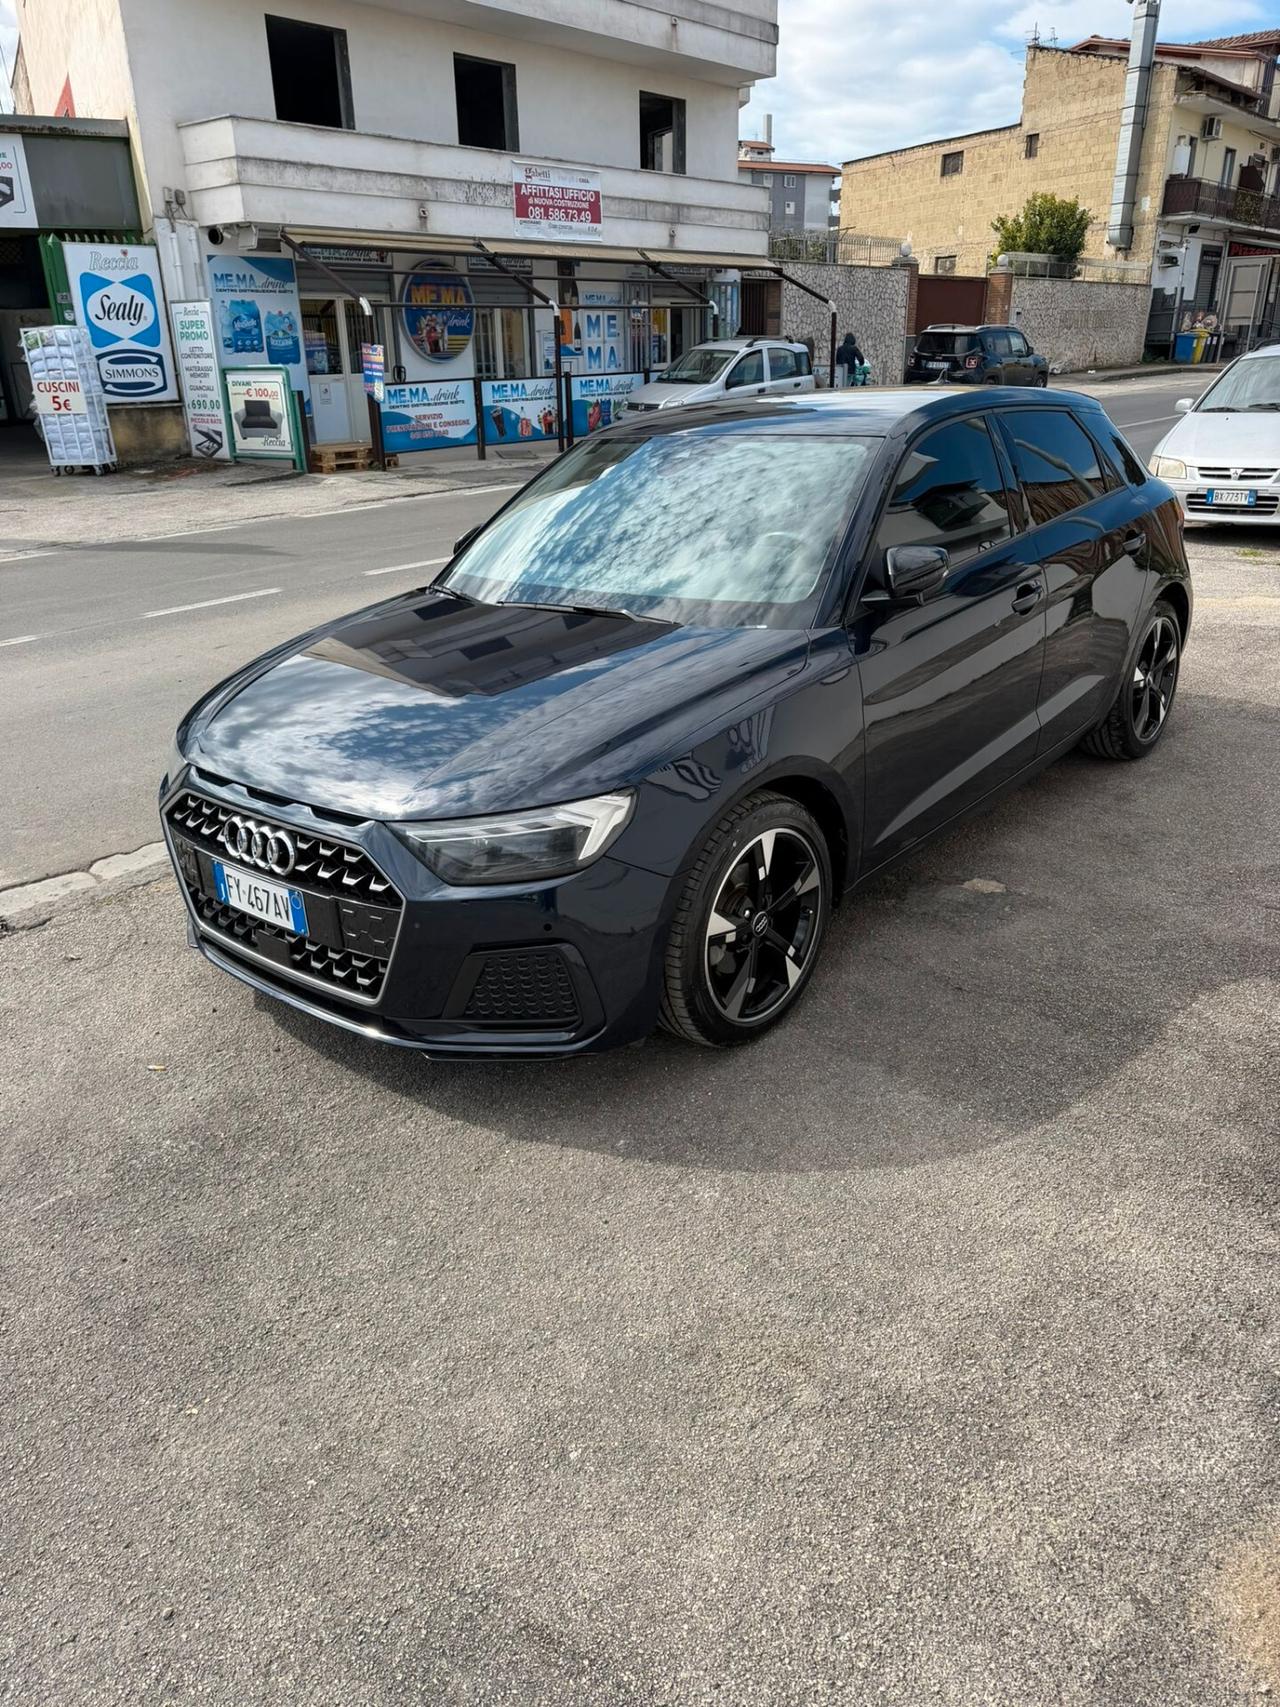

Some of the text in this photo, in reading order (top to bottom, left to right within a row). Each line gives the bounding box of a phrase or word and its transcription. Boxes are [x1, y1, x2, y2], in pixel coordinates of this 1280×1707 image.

[520, 184, 562, 199] AFFITTASI
[563, 188, 596, 202] UFFICIO
[534, 198, 553, 206] NUOVA
[553, 199, 589, 209] COSTRUZIONE
[89, 251, 140, 271] Reccia
[94, 294, 144, 326] Sealy
[179, 319, 206, 330] SUPER
[447, 312, 471, 329] drink
[180, 330, 209, 341] PROMO
[105, 367, 159, 379] SIMMONS
[36, 381, 80, 393] CUSCINI
[432, 385, 459, 401] drink
[530, 382, 554, 397] drink
[415, 413, 443, 421] SERVIZIO
[438, 419, 470, 428] CONSEGNE
